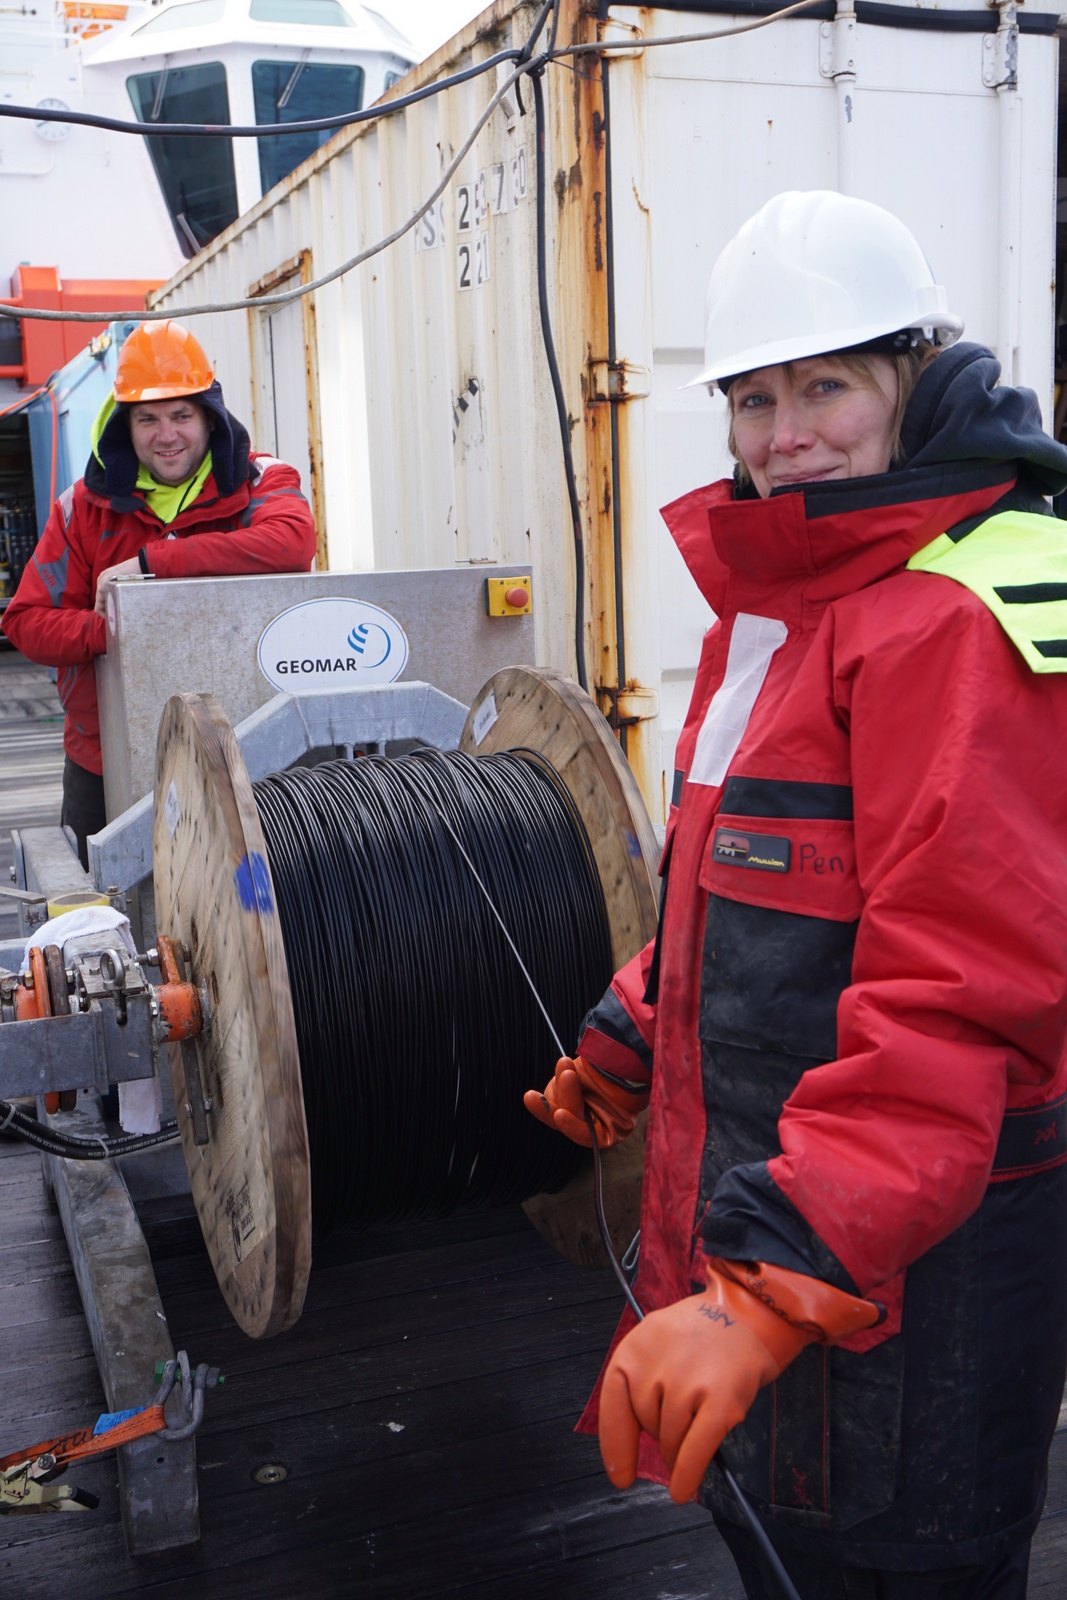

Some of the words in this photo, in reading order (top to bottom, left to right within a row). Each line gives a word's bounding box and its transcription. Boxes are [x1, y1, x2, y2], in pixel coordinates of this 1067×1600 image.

[276, 658, 357, 674] GEOMAR
[748, 856, 785, 867] Mullion
[800, 843, 845, 874] Pen
